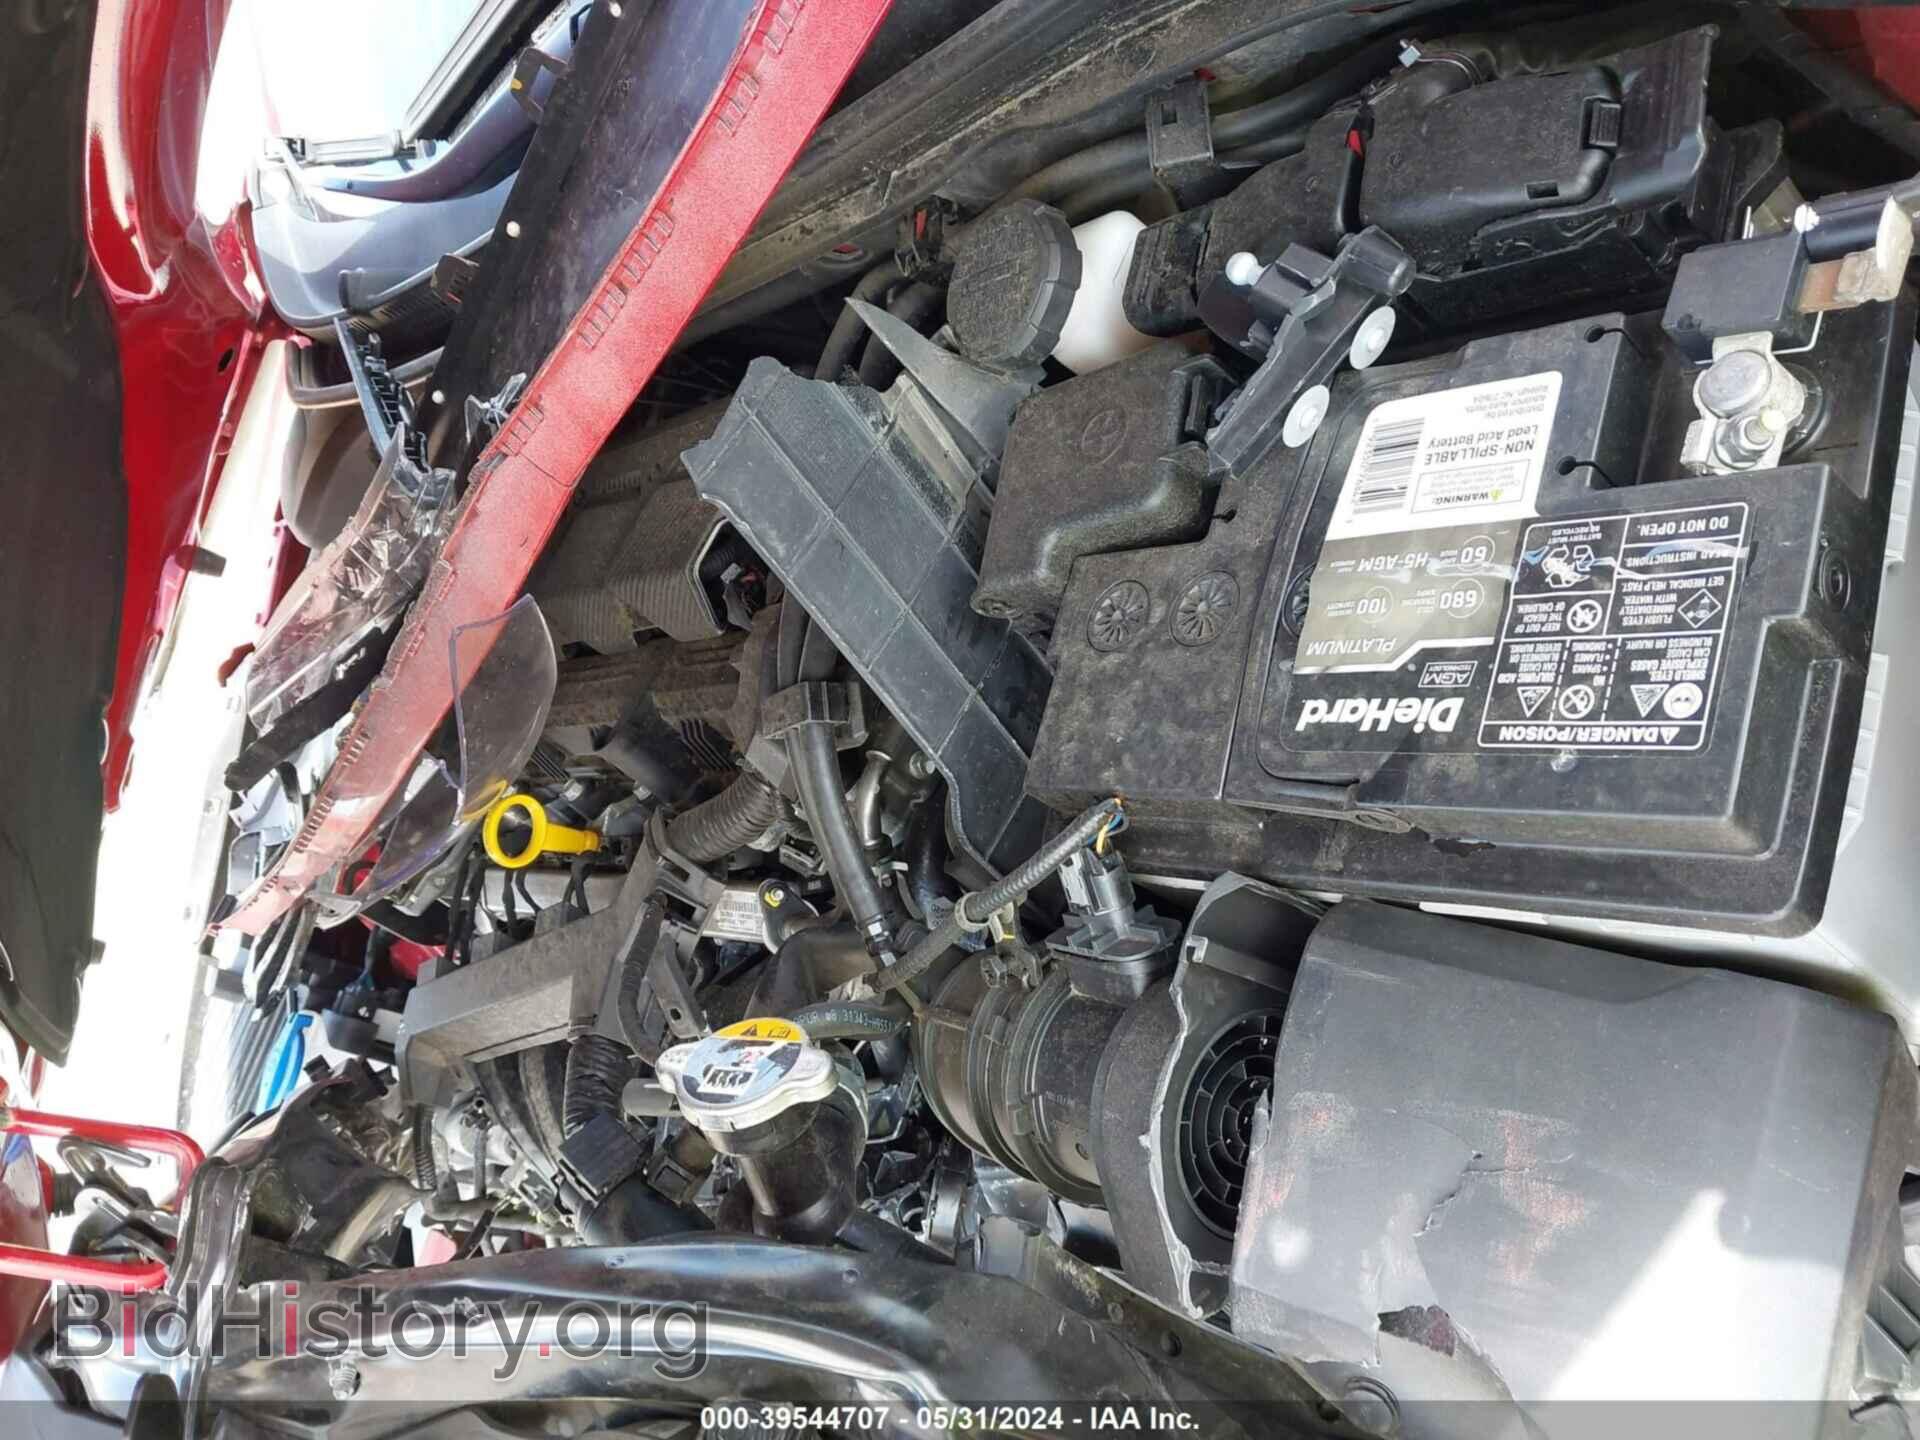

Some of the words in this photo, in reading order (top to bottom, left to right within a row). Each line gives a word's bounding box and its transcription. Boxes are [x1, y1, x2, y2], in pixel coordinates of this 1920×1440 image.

[1507, 424, 1538, 438] Lead
[1428, 434, 1474, 449] Battery
[1478, 430, 1504, 444] Acid
[1424, 439, 1534, 465] NON-SPILLABLE
[1678, 518, 1706, 533] NOT
[1710, 516, 1728, 530] DO
[1636, 522, 1676, 536] OPEN.
[1460, 546, 1488, 564] 60
[1357, 552, 1428, 572] H5-AGM
[1644, 580, 1667, 591] HELP
[1669, 578, 1706, 589] MEDICAL
[1708, 575, 1724, 586] GET
[1440, 590, 1478, 609] 680
[1655, 592, 1677, 603] WITH
[1356, 597, 1388, 614] 100
[1554, 601, 1566, 611] OF
[1619, 604, 1676, 616] IMMEDIATELY
[1522, 613, 1548, 623] REACH
[1547, 612, 1562, 622] THE
[1622, 615, 1644, 626] EYES
[1644, 614, 1673, 625] FLUSH
[1514, 624, 1525, 634] OF
[1525, 623, 1541, 633] OUT
[1541, 622, 1560, 632] KEEP
[1305, 638, 1398, 656] PLATINUM
[1693, 647, 1710, 658] CAN
[1574, 653, 1604, 662] FLAMES
[1572, 663, 1602, 674] SPARKS
[1630, 660, 1659, 671] GASES
[1660, 658, 1708, 670] EXPLOSIVE
[1423, 672, 1470, 684] AGM
[1674, 670, 1706, 680] SHIELD
[1294, 696, 1464, 734] DieHard
[1499, 725, 1660, 742] DANGER/POISON
